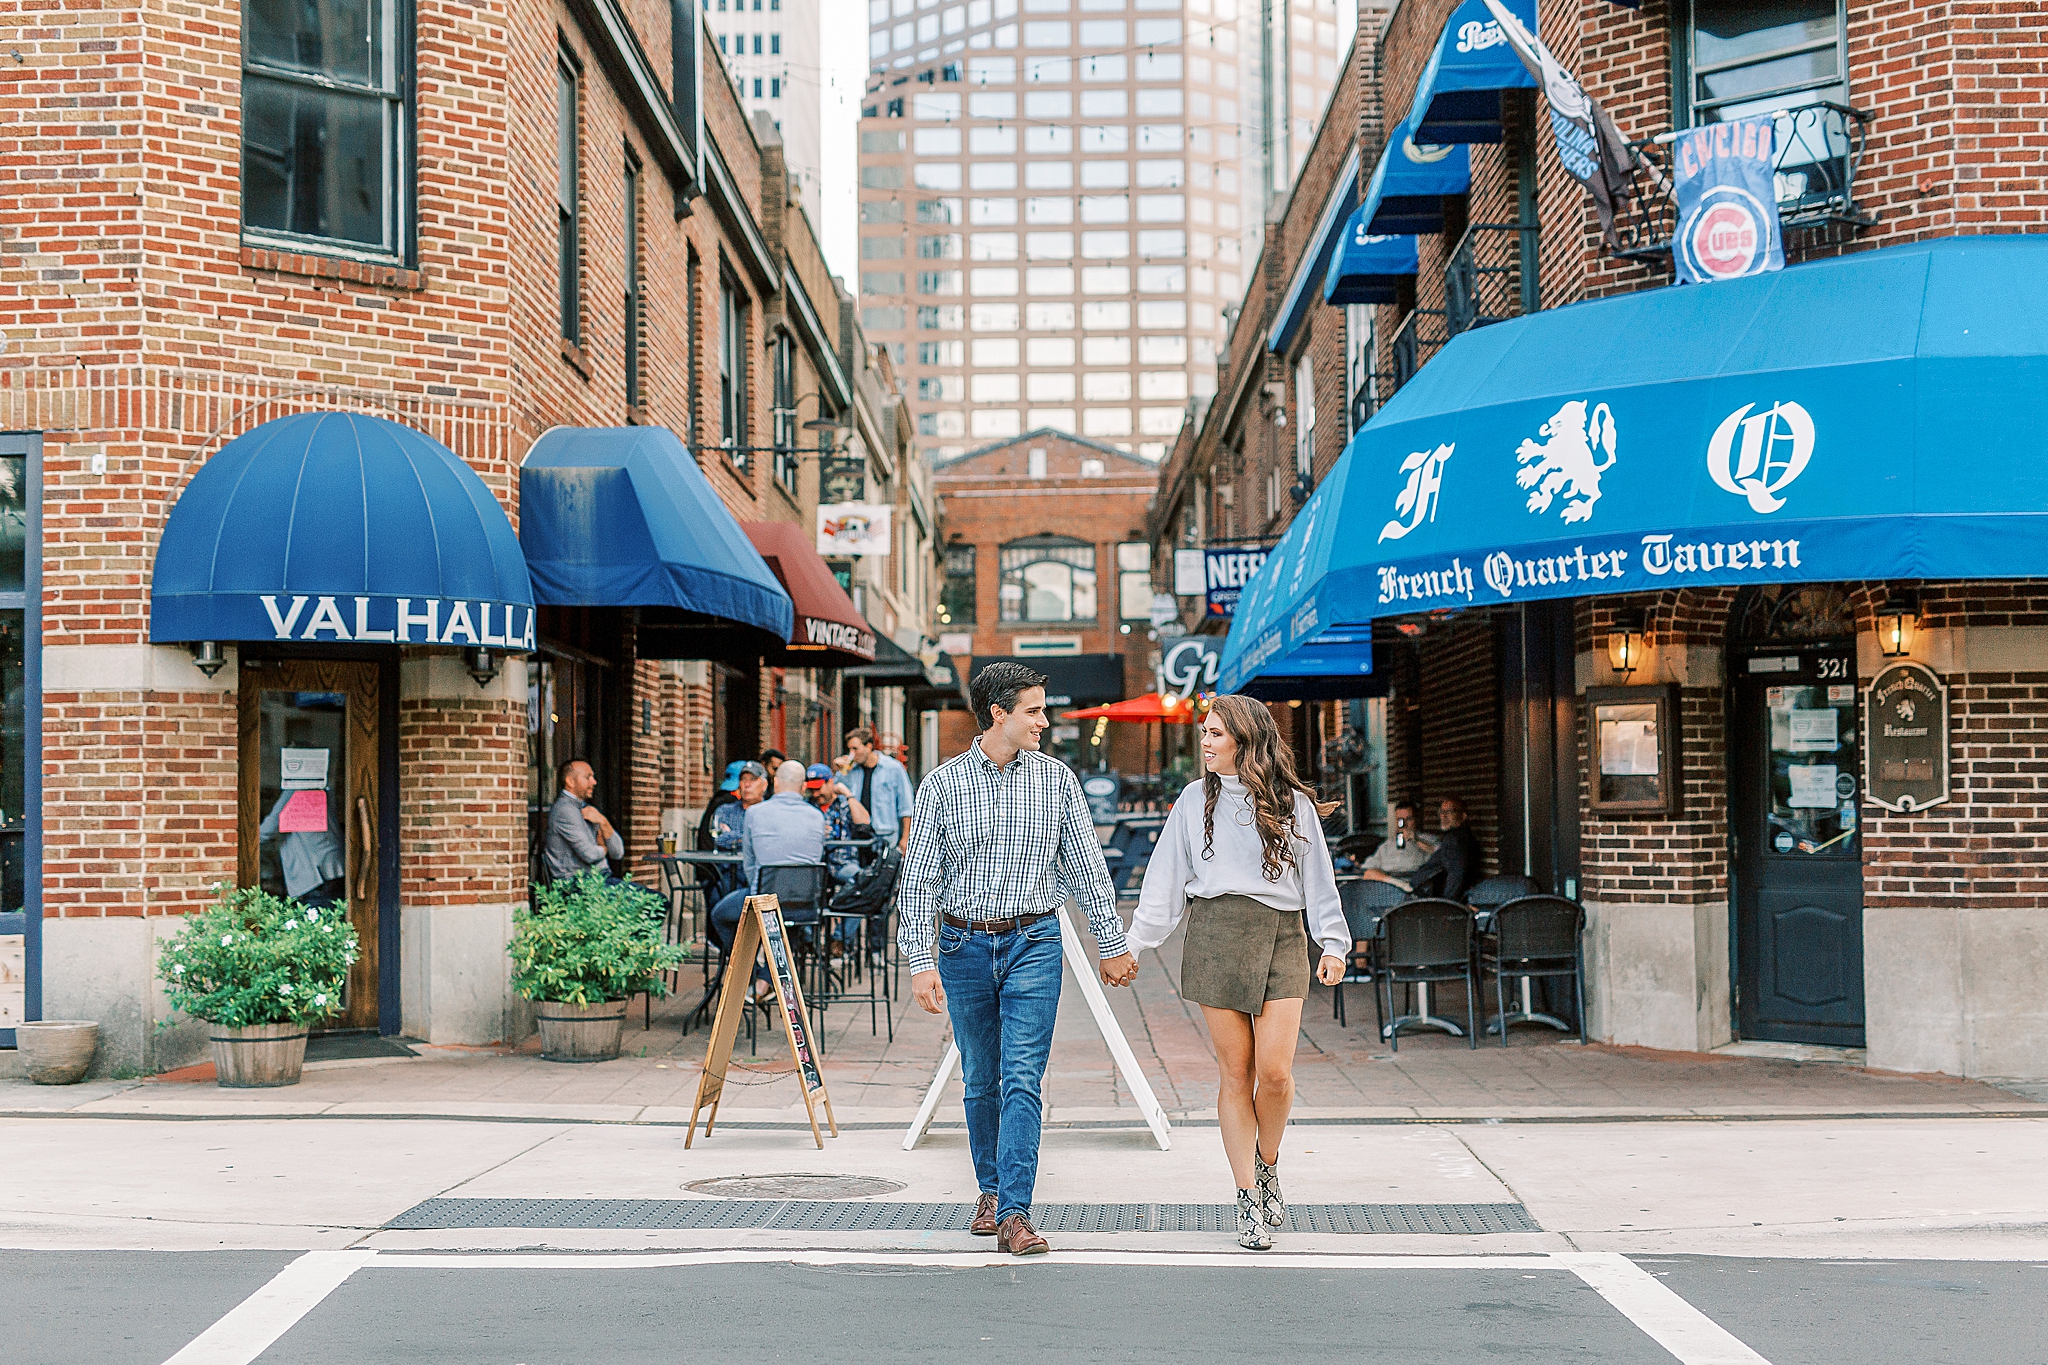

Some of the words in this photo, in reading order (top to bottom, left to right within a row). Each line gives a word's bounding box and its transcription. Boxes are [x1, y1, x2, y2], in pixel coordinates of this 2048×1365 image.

[1707, 400, 1816, 514] Q
[1377, 557, 1475, 604] French
[1483, 545, 1628, 597] Quarter
[1641, 534, 1801, 575] Tavern
[260, 595, 536, 650] VALHALLA
[1816, 657, 1849, 679] 321
